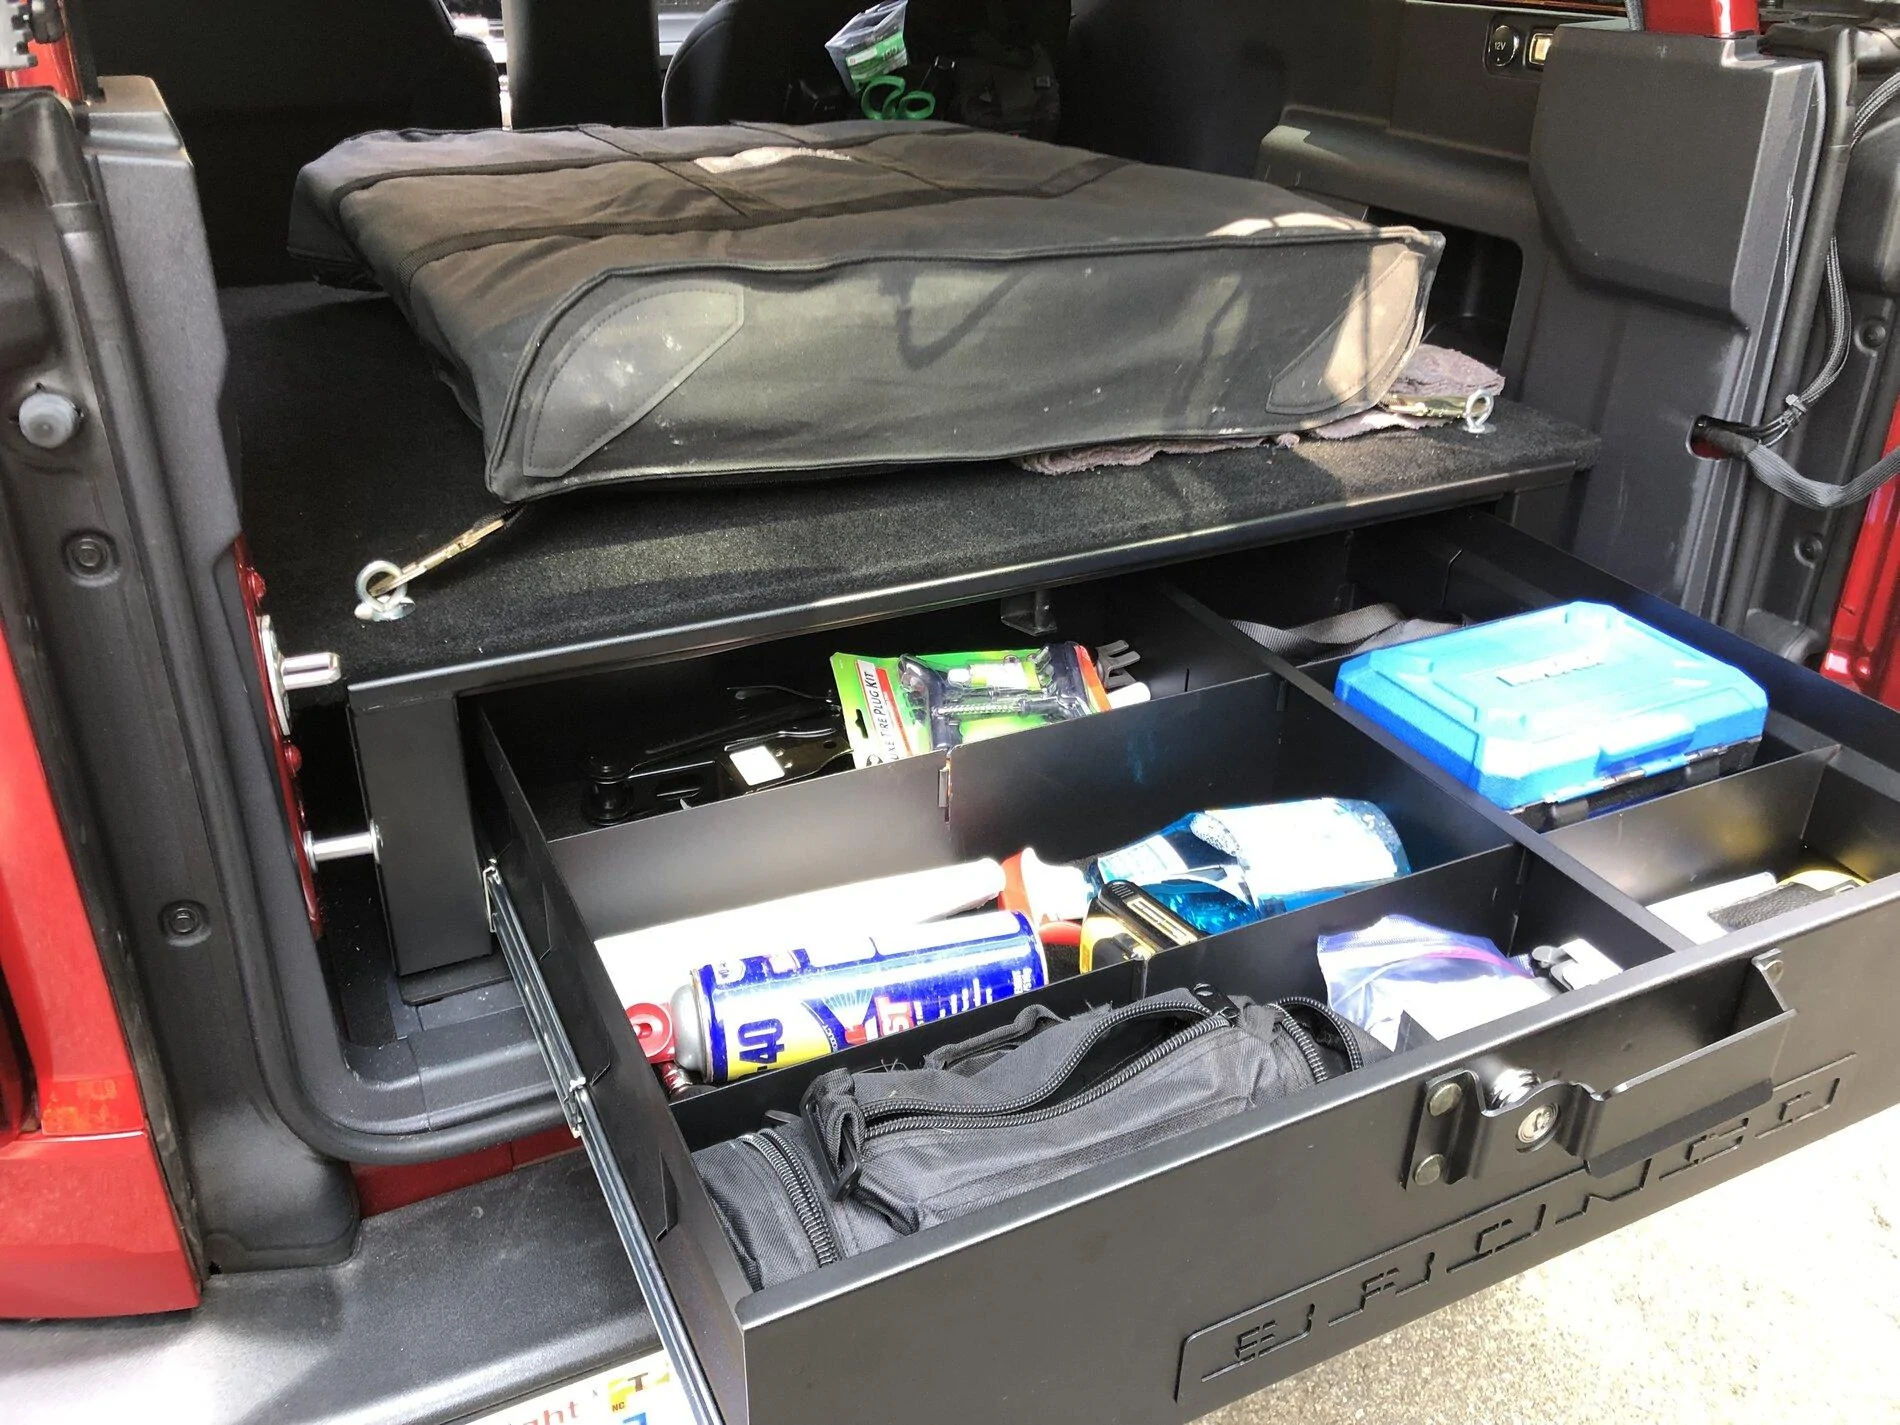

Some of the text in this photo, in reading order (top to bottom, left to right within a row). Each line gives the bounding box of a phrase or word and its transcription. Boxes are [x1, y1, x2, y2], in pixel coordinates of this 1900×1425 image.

[1494, 41, 1506, 51] 12V
[864, 671, 879, 689] KIT
[870, 690, 886, 716] PLUG
[876, 997, 911, 1037] ST
[738, 1018, 785, 1076] -40
[611, 1401, 625, 1412] NC
